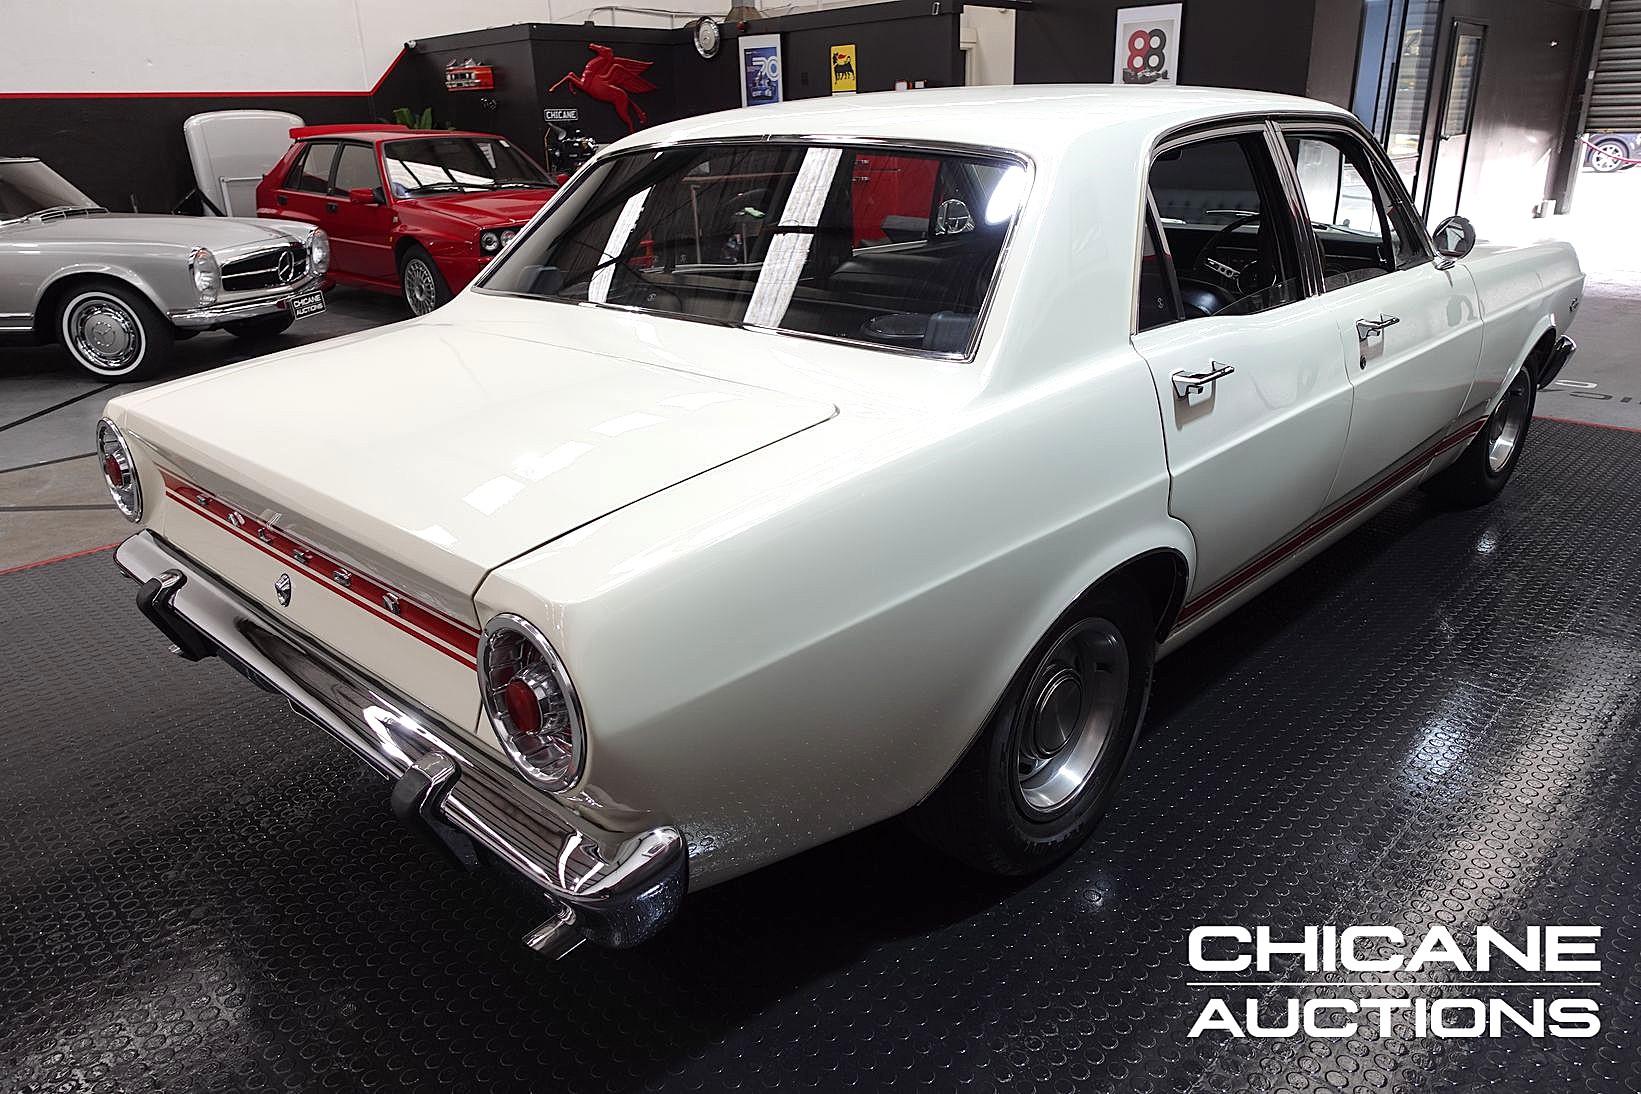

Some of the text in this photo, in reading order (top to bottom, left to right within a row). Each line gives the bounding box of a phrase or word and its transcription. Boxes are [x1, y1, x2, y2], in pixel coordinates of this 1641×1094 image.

[752, 55, 780, 81] 70
[546, 110, 577, 119] CHICANE
[293, 294, 322, 308] CHICANE
[296, 302, 323, 316] AUCTIONS
